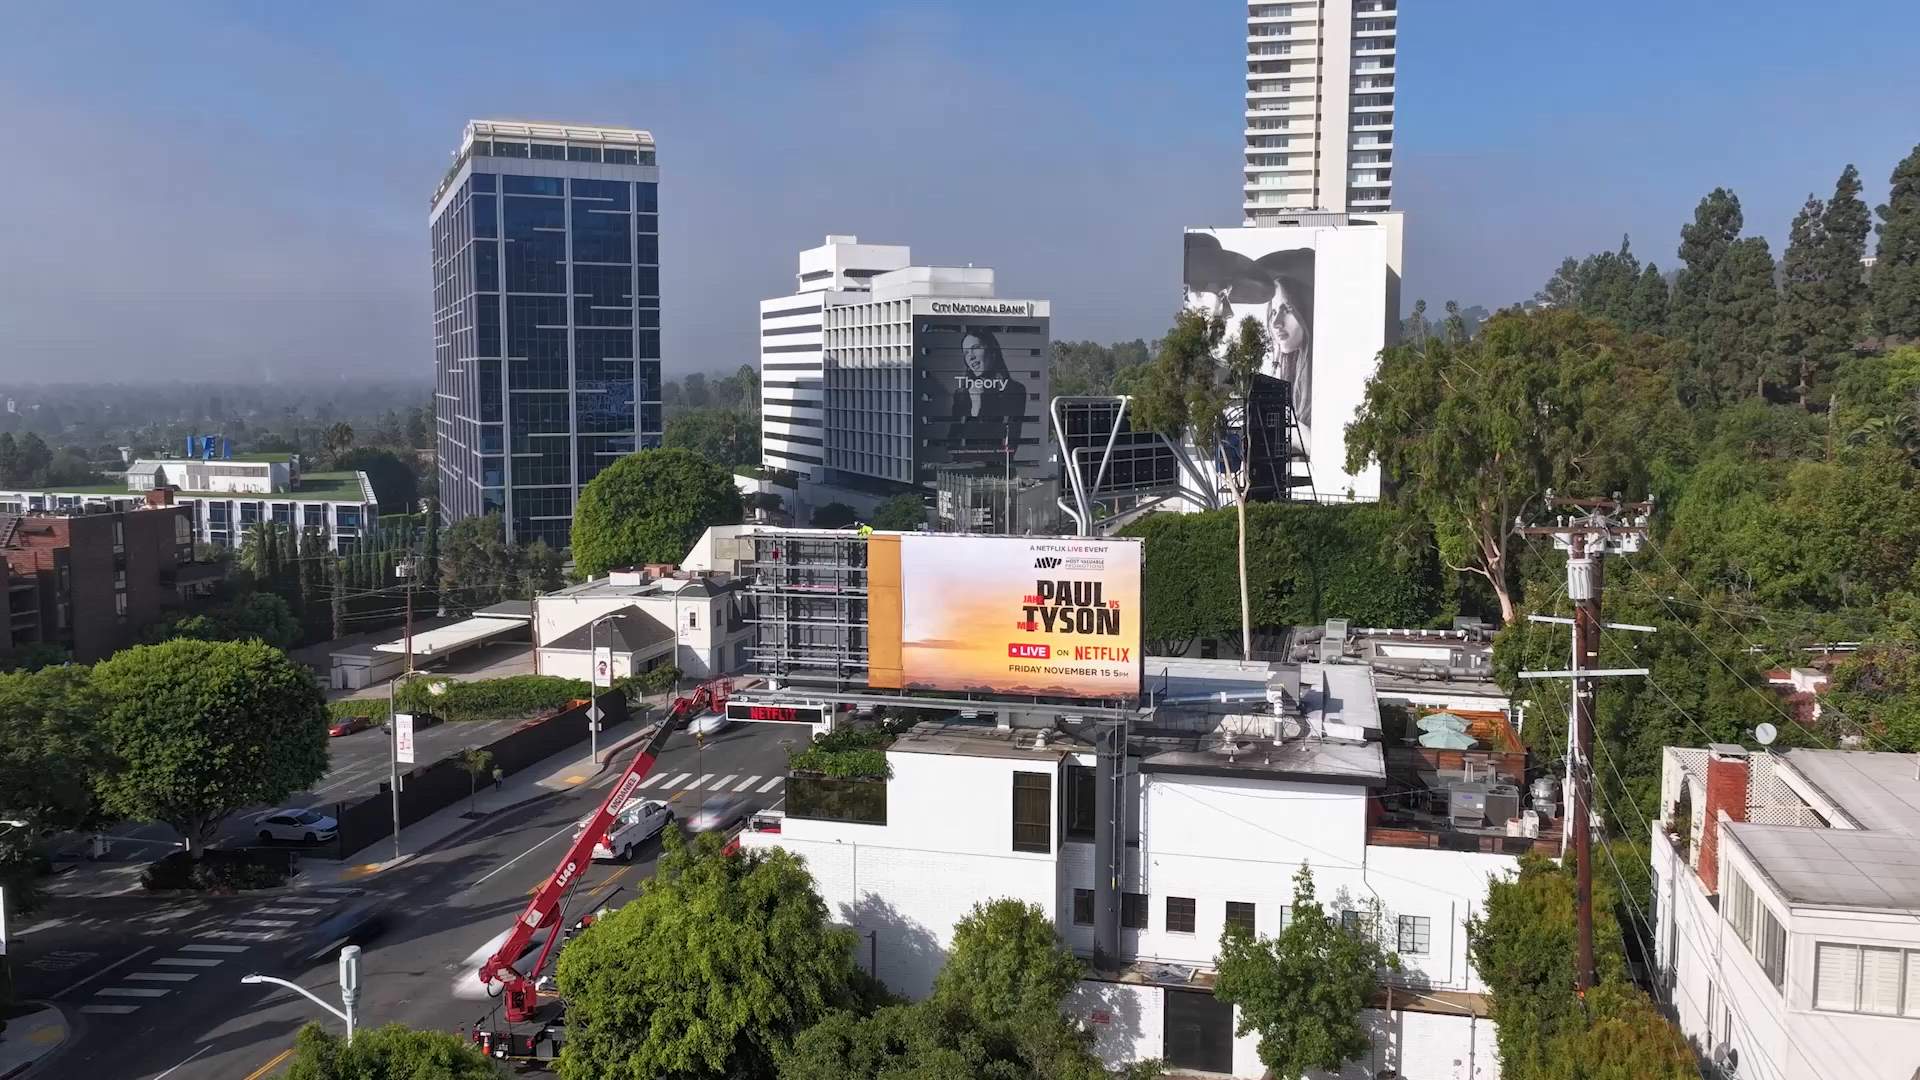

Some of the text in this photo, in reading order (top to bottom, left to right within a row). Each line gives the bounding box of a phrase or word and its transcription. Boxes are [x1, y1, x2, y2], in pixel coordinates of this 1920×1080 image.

[932, 302, 1026, 315] CITY NATIONAL BANK
[954, 376, 1009, 391] Theory
[1036, 579, 1107, 607] PAUL
[1109, 600, 1120, 609] VS
[1022, 605, 1120, 636] TYSON
[1019, 646, 1046, 657] LIVE
[1074, 645, 1130, 663] NETFLIX
[1008, 664, 1129, 677] FRIDAY NOVEMBER 15 5PM
[750, 706, 797, 721] NETFLIX
[555, 862, 577, 887] L140
